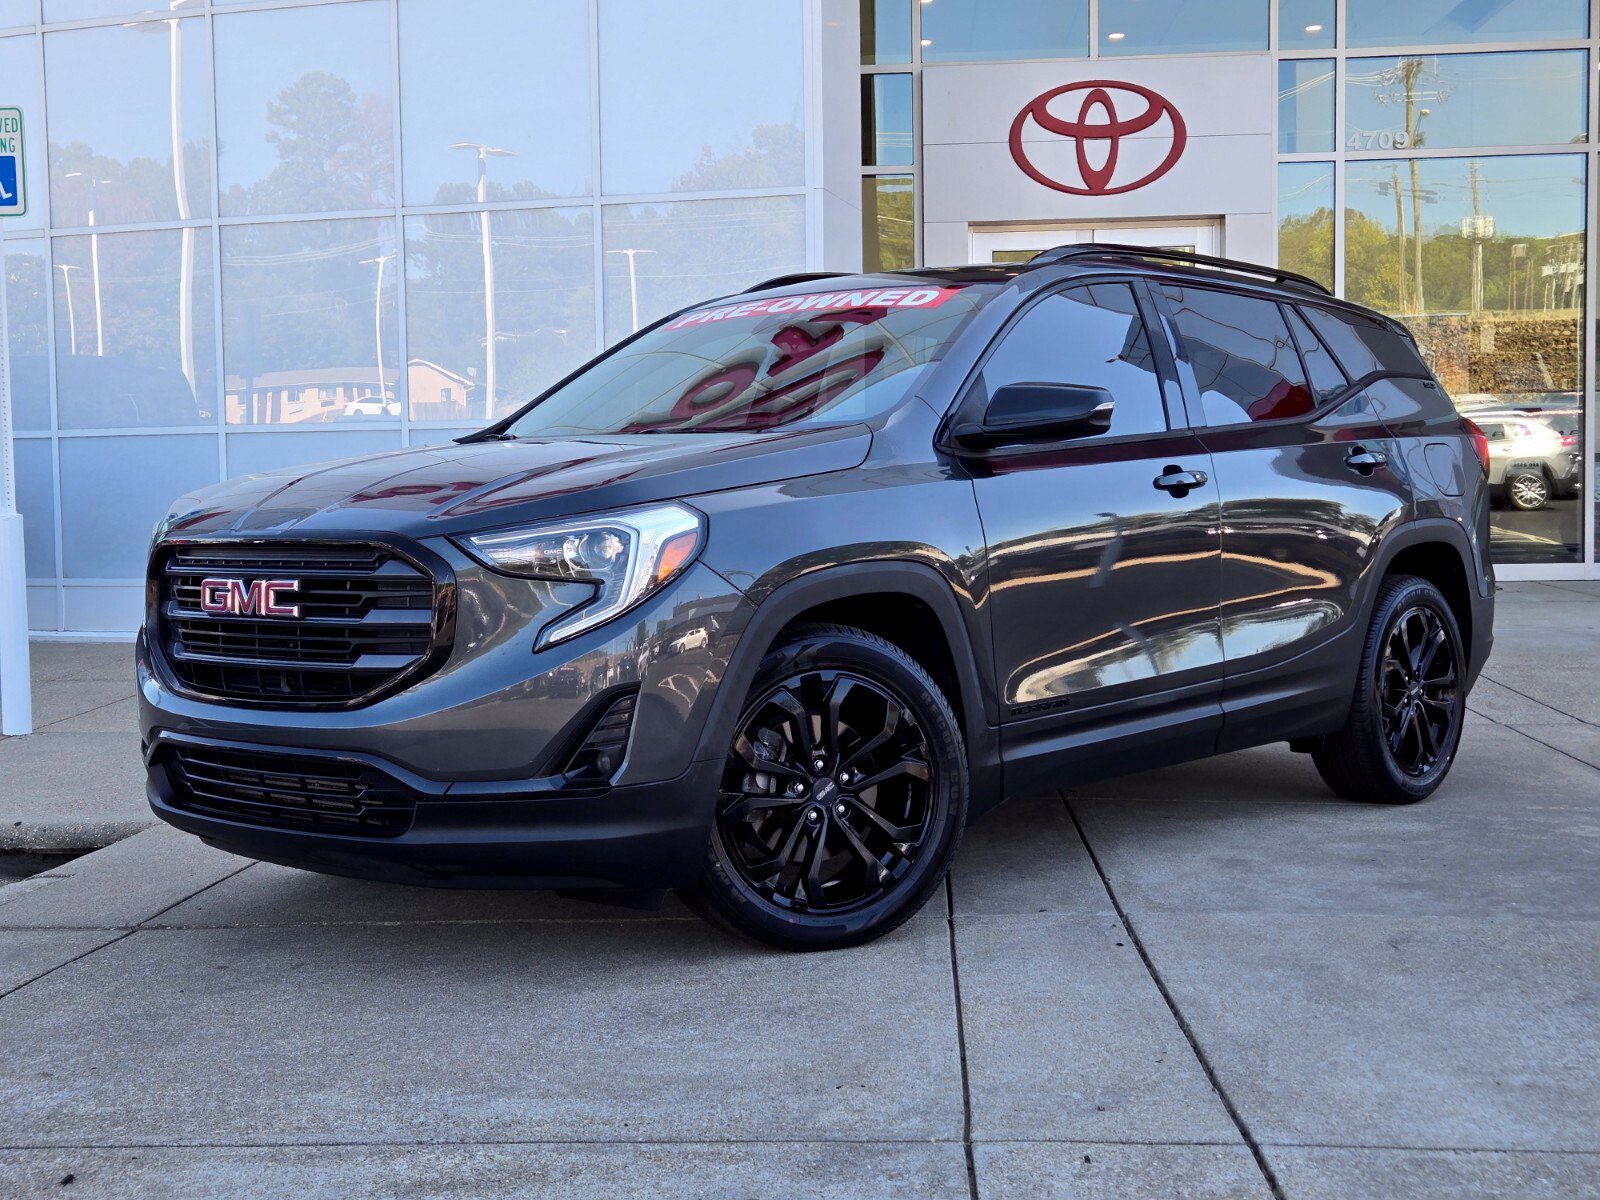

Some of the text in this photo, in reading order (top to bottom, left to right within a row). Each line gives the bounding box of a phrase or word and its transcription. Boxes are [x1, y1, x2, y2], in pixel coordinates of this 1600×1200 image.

[1346, 131, 1409, 150] 4709
[673, 289, 940, 329] PRE-OWNED
[201, 578, 299, 617] GMC
